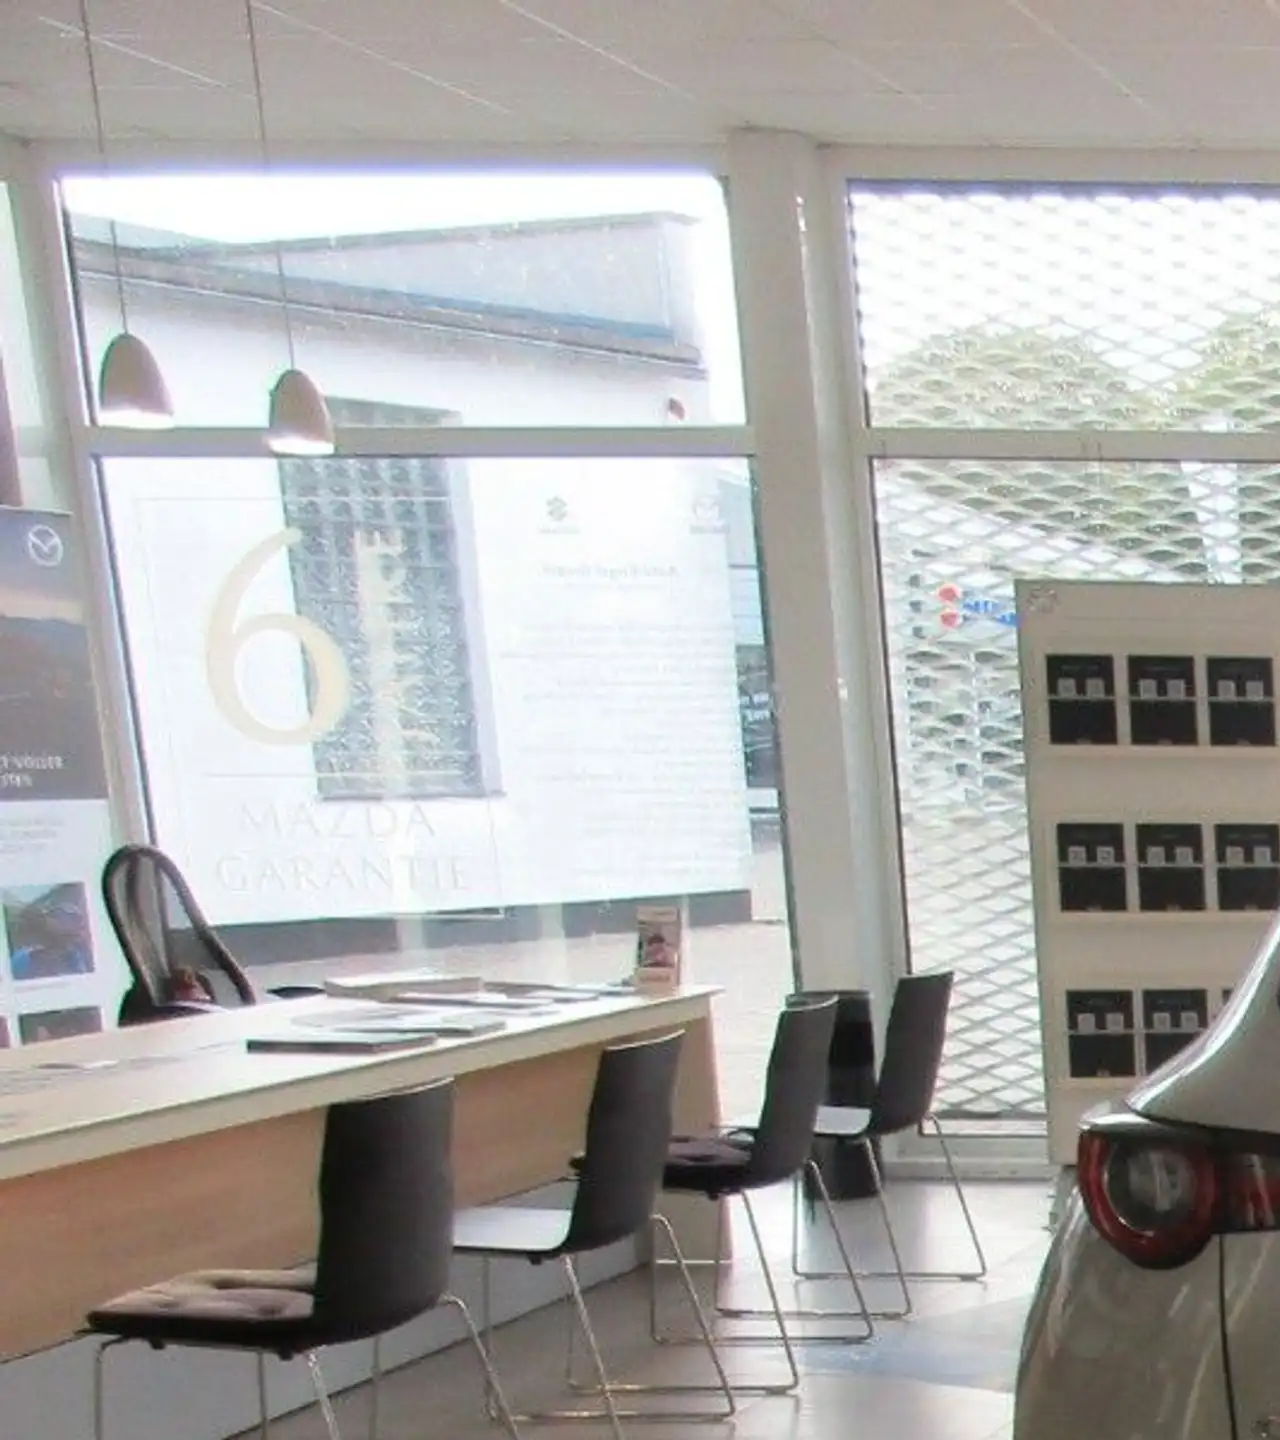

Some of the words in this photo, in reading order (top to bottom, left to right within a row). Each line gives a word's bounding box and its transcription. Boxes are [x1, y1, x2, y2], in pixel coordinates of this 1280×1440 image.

[206, 526, 350, 746] 6
[240, 801, 435, 839] MAZDA
[216, 855, 469, 891] GARANTIE
